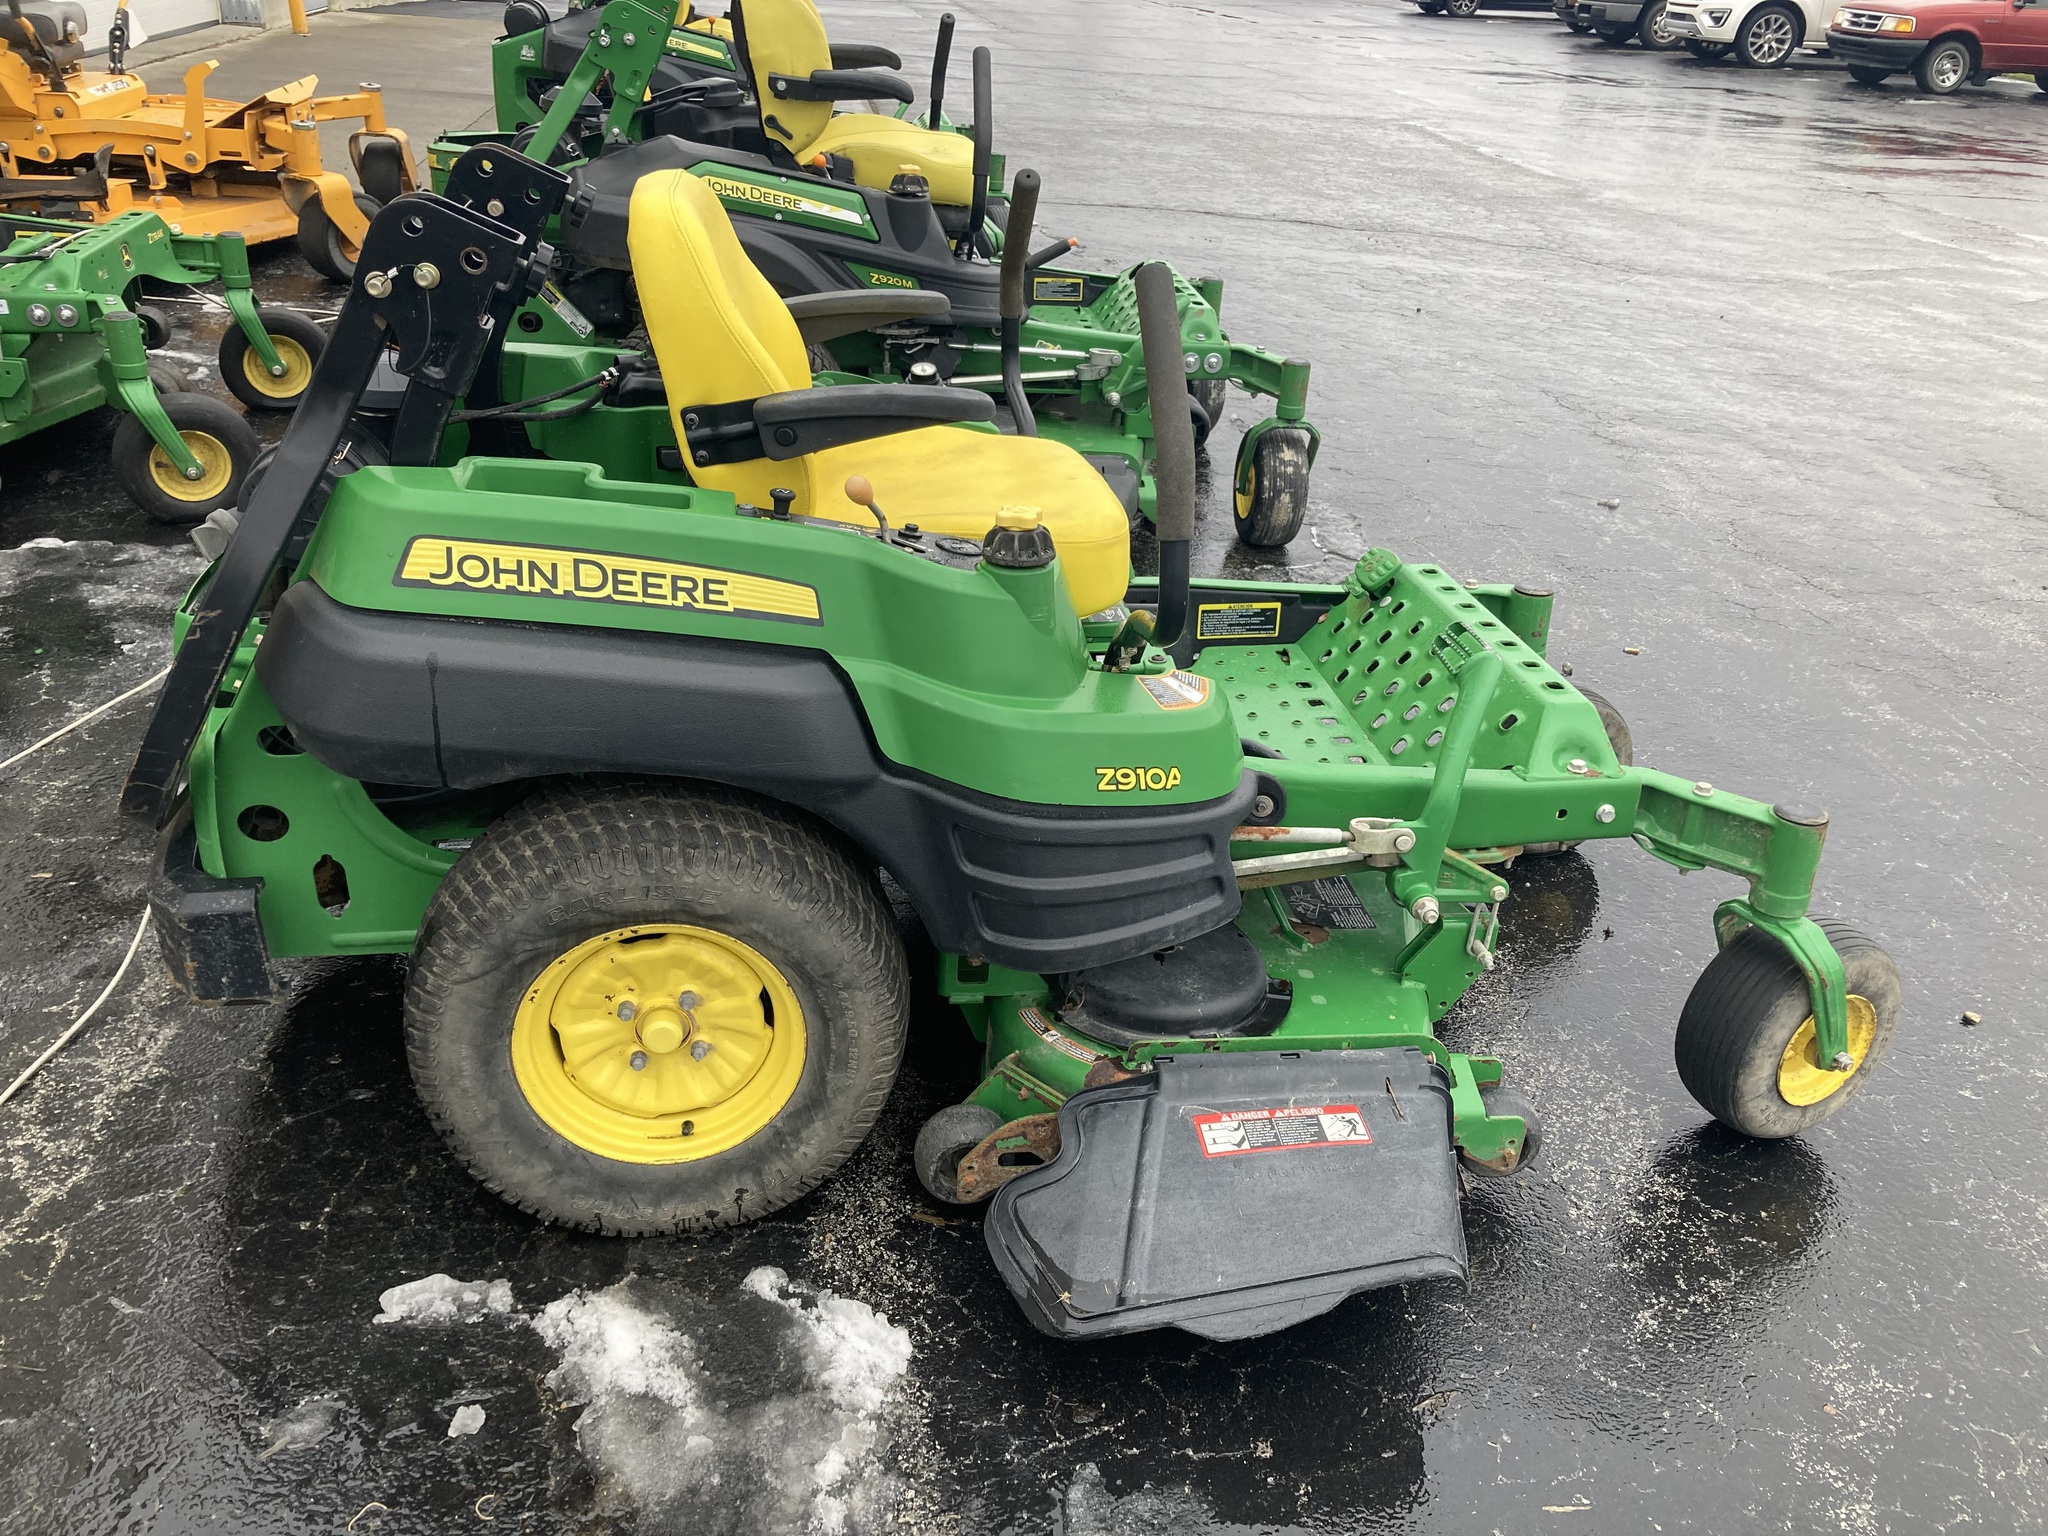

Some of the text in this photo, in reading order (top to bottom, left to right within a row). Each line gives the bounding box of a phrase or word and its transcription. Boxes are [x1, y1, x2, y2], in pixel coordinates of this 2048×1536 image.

[669, 38, 688, 50] ERE
[750, 186, 803, 210] DEERE
[869, 272, 913, 289] Z920M
[428, 546, 730, 608] JOHN DEERE
[1094, 766, 1182, 791] Z910A
[545, 885, 723, 926] CARLISLE
[1230, 1107, 1325, 1121] DANGER PELIGRO
